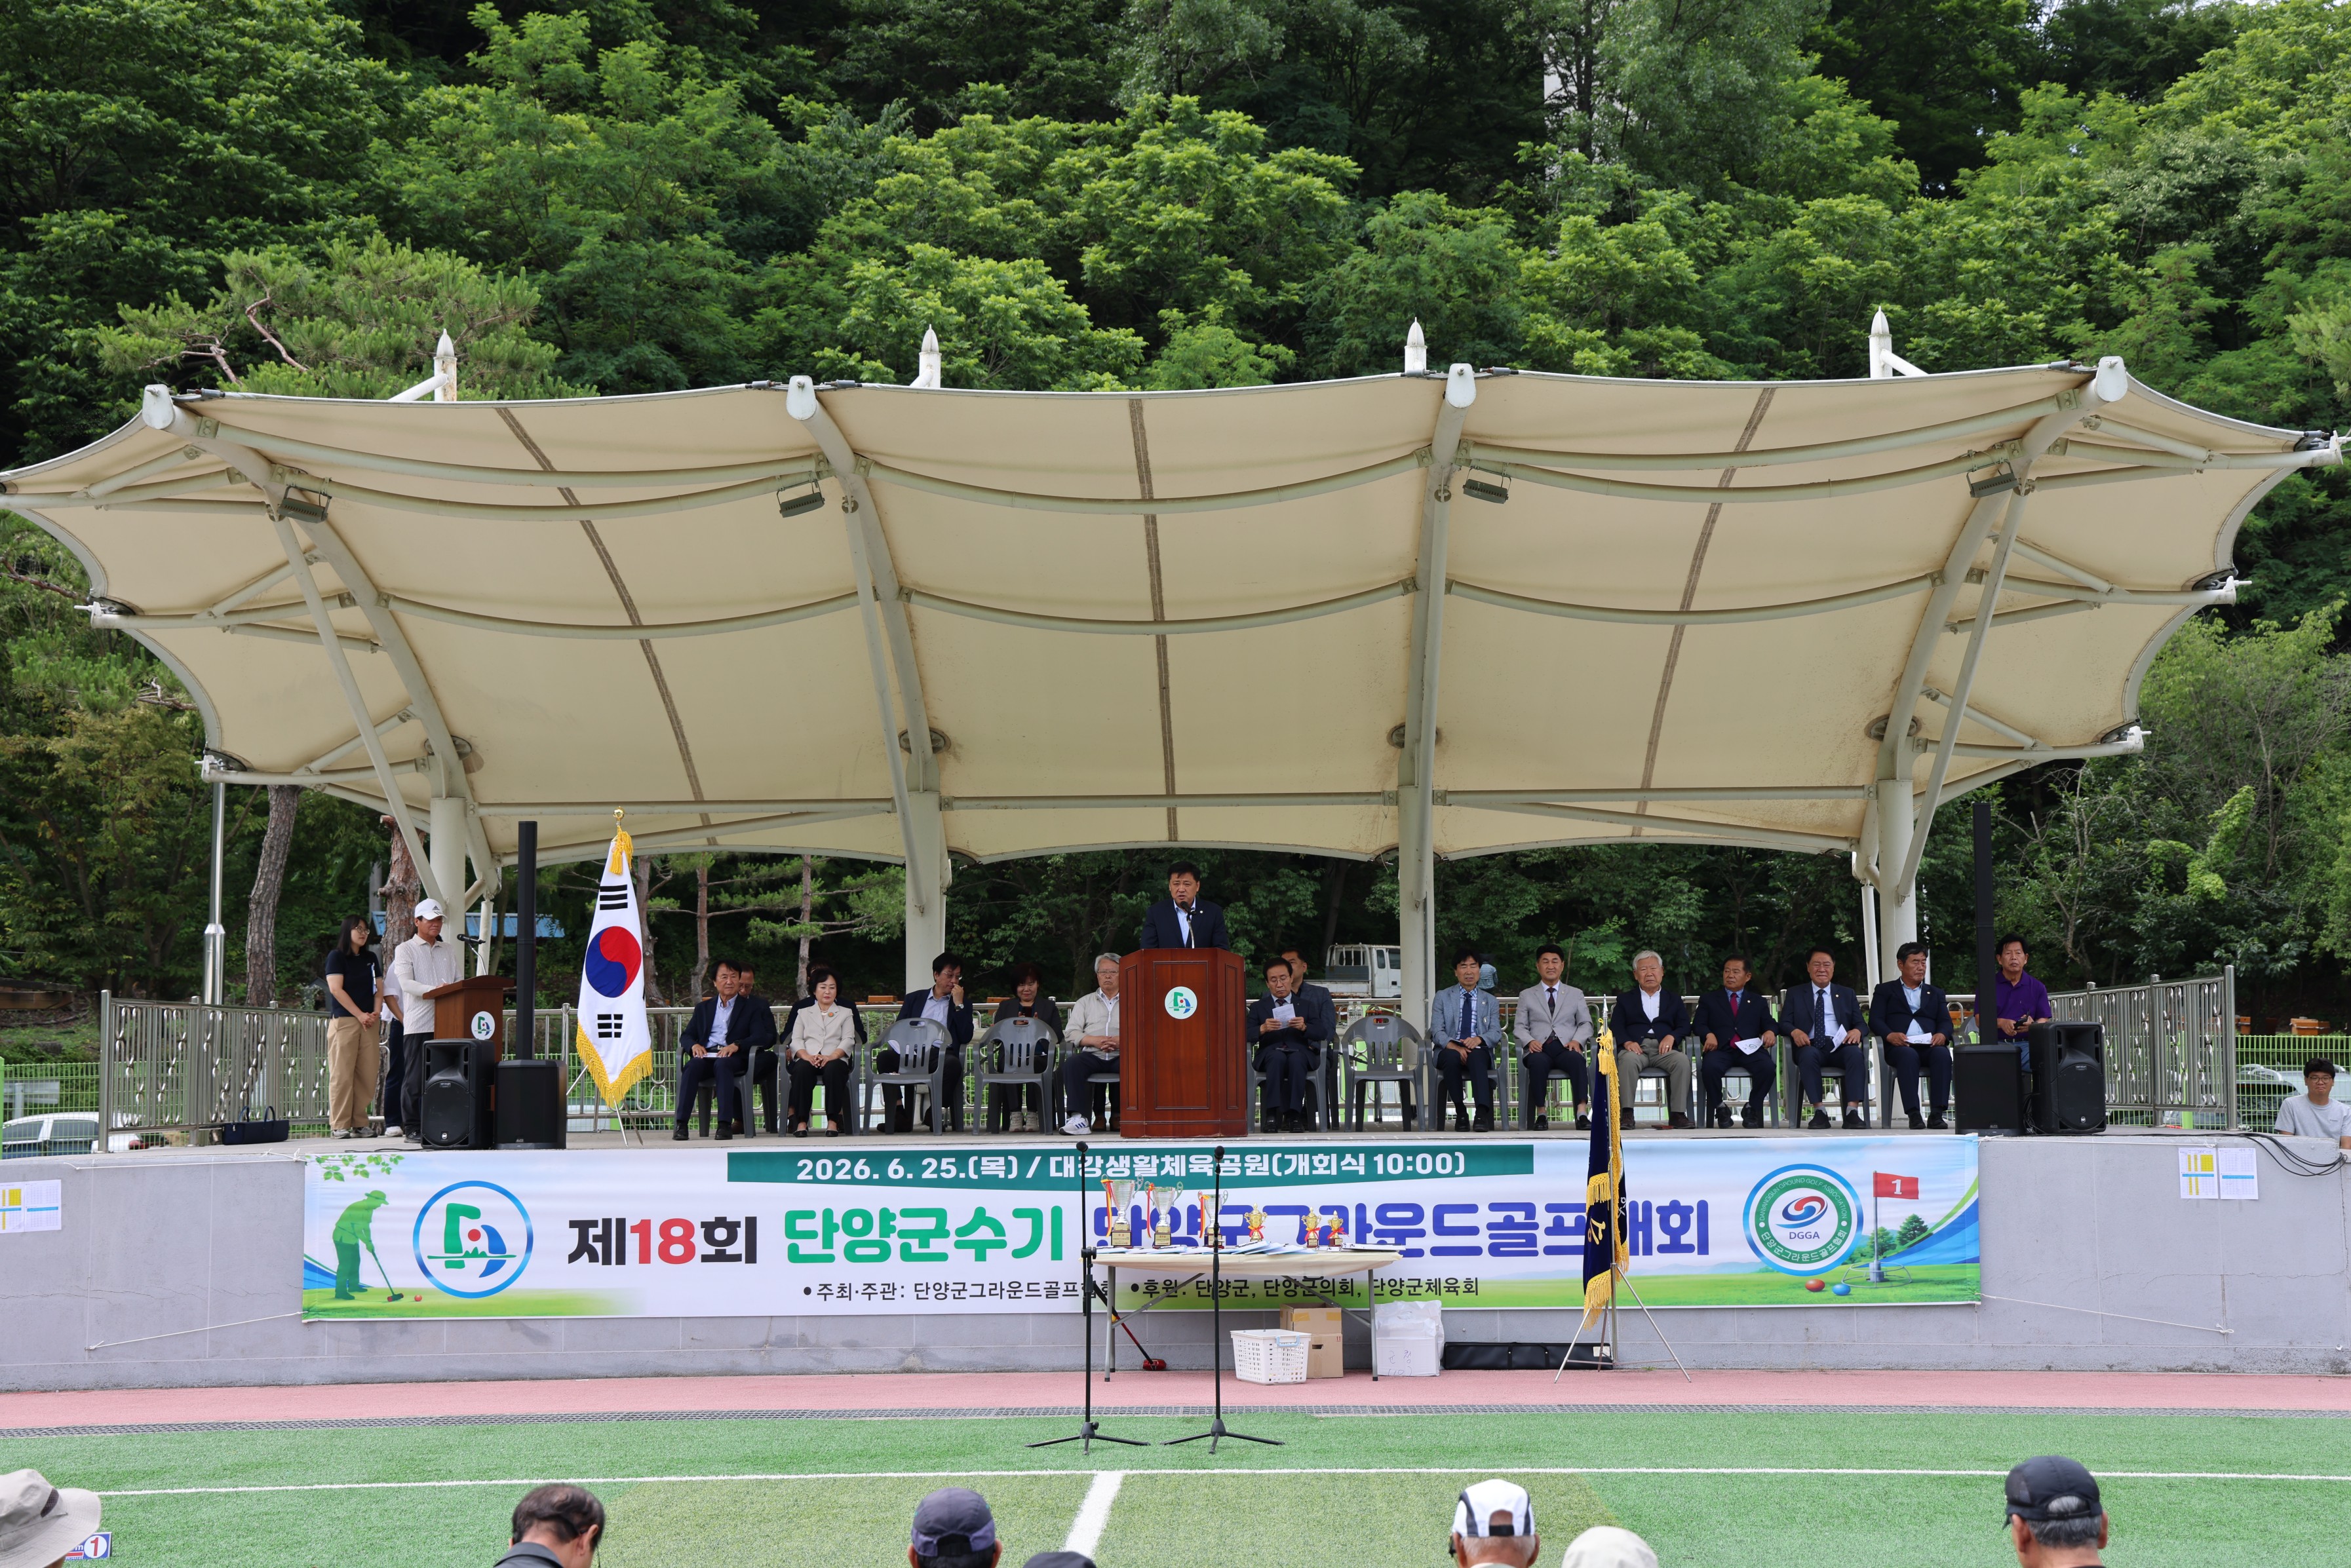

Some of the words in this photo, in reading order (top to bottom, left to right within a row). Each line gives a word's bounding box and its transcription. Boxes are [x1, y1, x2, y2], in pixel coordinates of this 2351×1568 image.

[796, 1158, 880, 1180] 2026.
[887, 1158, 913, 1179] 6.
[922, 1156, 1018, 1179] 25.(목)
[1373, 1152, 1465, 1177] 10:00)
[1759, 1187, 1780, 1221] DANYANGGUN
[1779, 1177, 1805, 1189] GROUND
[1823, 1184, 1848, 1219] ASSOCIATION
[1892, 1179, 1902, 1195] 1
[568, 1216, 757, 1265] 제18회
[785, 1206, 1063, 1263] 단양군수기
[1761, 1229, 1848, 1262] 단양군그라운드골프협회
[1789, 1231, 1820, 1240] DGGA
[914, 1280, 1108, 1301] 단양군그라운드골프
[1374, 1276, 1479, 1297] 단양군체육회
[90, 1537, 99, 1557] 1
